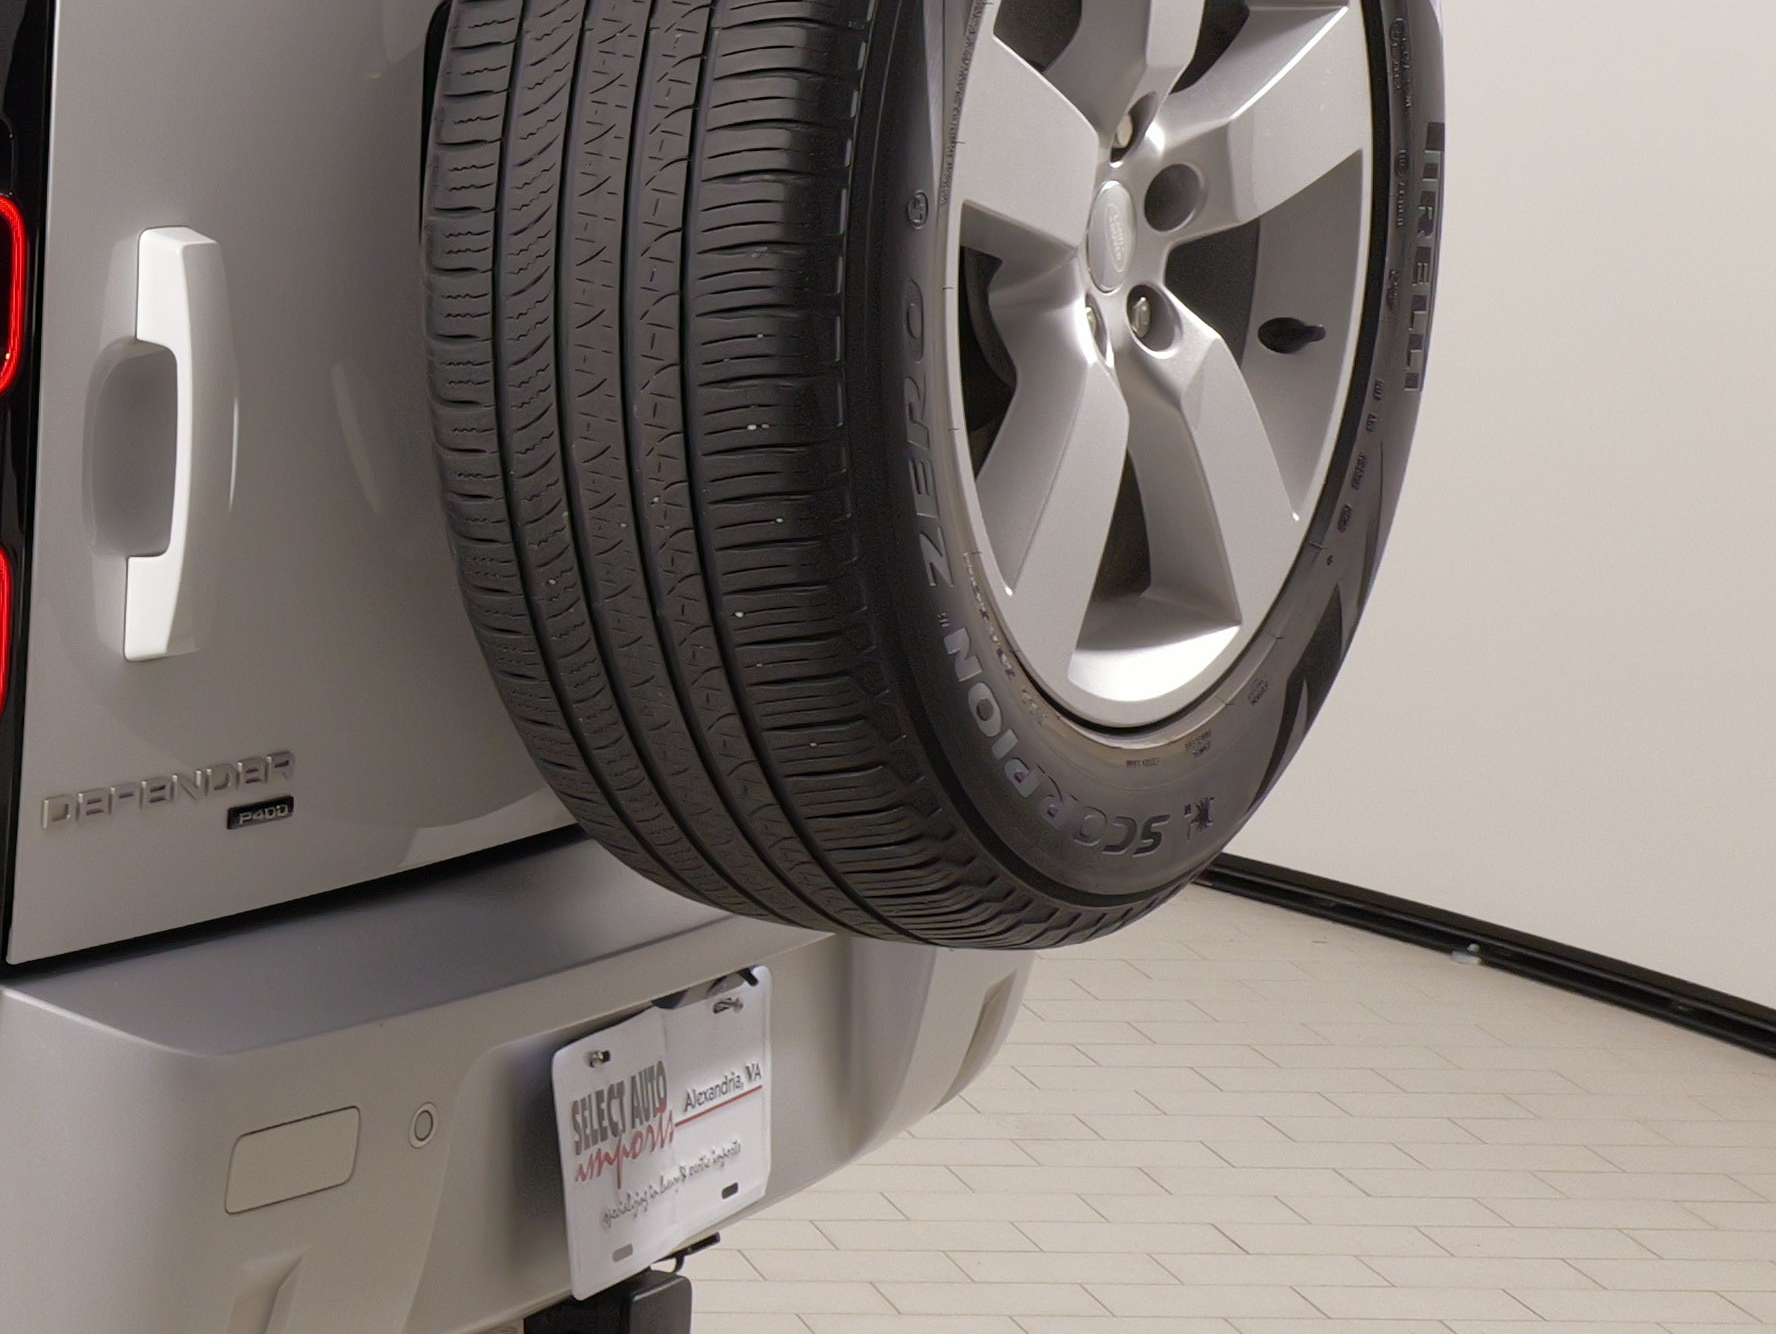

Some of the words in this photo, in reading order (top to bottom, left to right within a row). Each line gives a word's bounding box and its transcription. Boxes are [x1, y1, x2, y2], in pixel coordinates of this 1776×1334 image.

[943, 626, 1171, 858] SCORPION
[41, 750, 295, 831] DEFENDER
[239, 804, 290, 826] P400
[571, 1080, 626, 1157] SELECT
[630, 1060, 668, 1129] AUTO
[684, 1072, 744, 1113] Alexandria,
[745, 1063, 762, 1083] VA
[575, 1110, 675, 1189] imports
